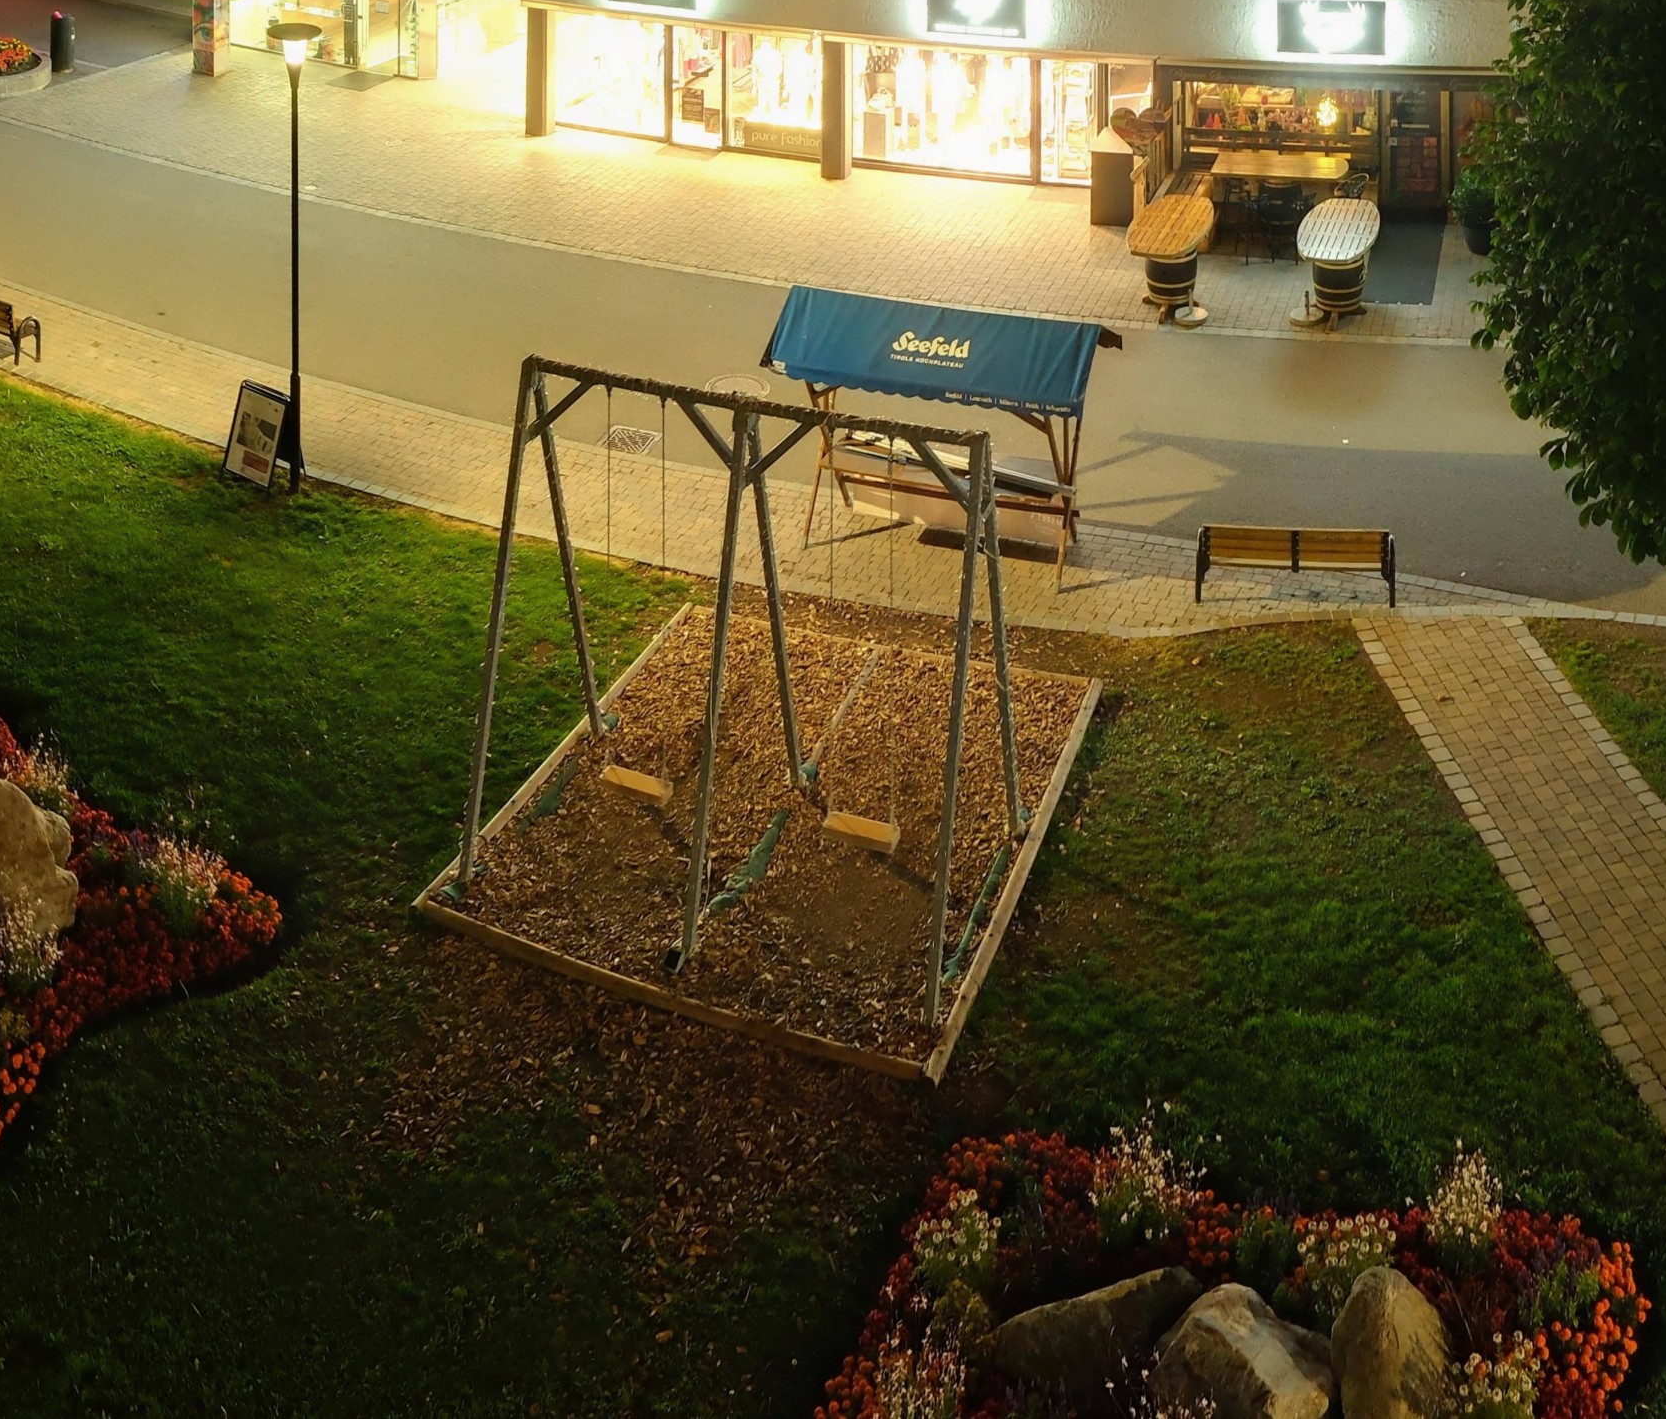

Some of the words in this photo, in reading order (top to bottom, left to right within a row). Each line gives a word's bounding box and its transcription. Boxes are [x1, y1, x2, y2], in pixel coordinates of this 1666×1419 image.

[751, 130, 779, 148] pure
[892, 330, 971, 360] Seefeld
[890, 354, 914, 364] TIROLS
[914, 357, 965, 369] HOCHPLATEAU
